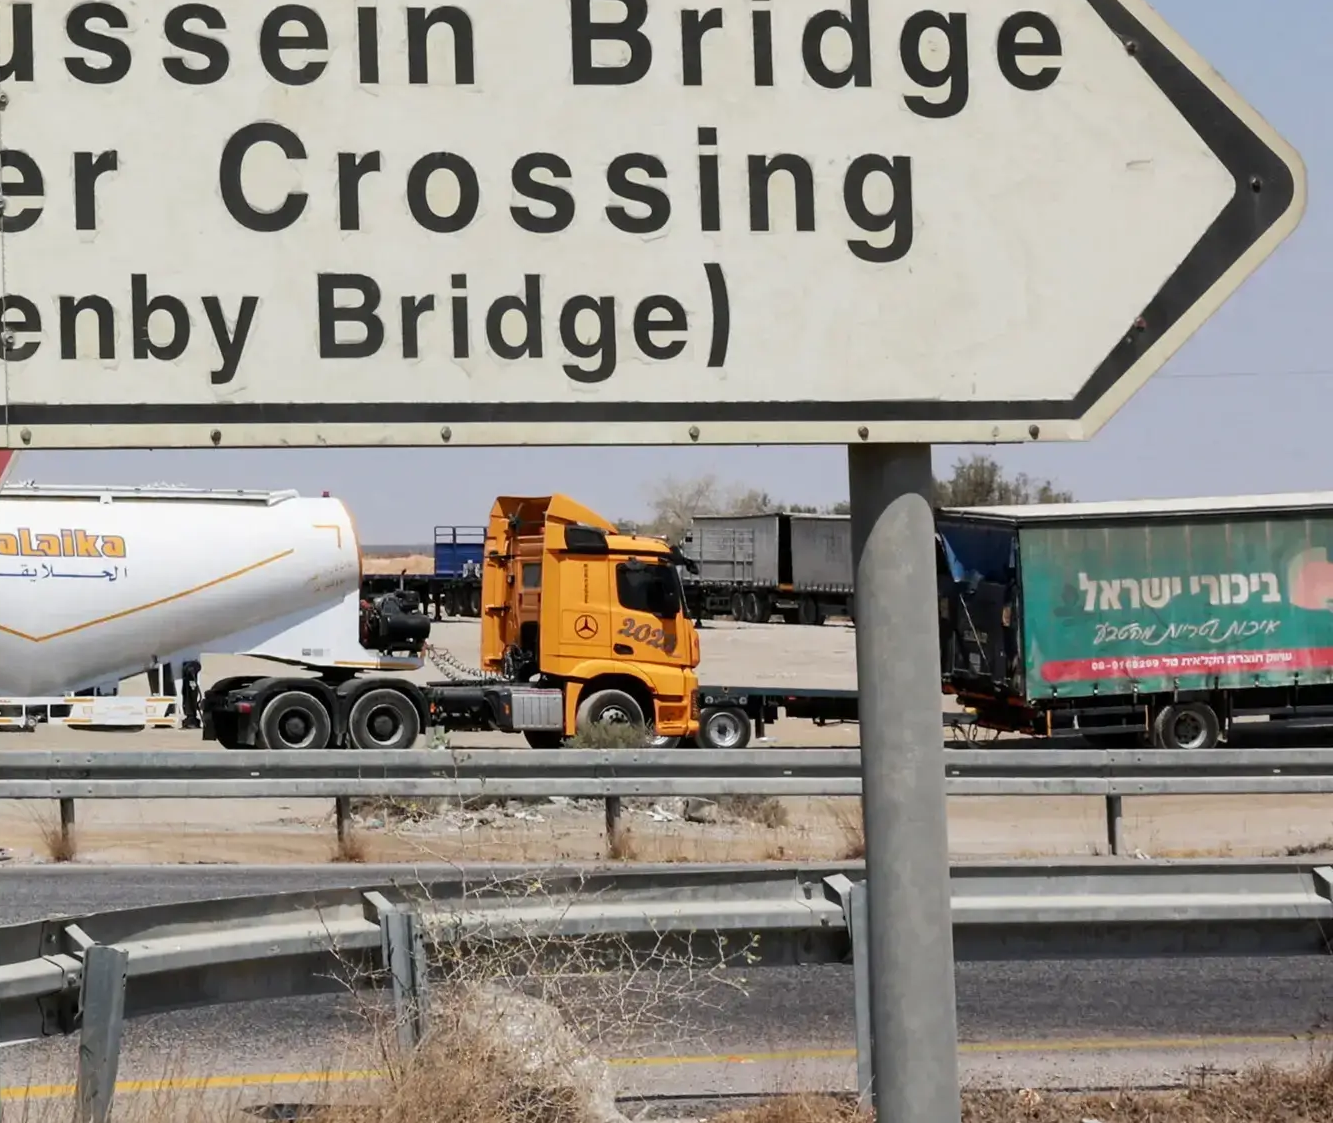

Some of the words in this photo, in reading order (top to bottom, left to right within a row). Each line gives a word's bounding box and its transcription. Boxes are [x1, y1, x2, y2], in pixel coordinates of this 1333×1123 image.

[220, 123, 913, 262] Crossing
[318, 263, 730, 384] Bridge)
[1078, 572, 1182, 612] ישראל
[1190, 572, 1282, 606] ביכורי
[1208, 619, 1282, 644] איכות
